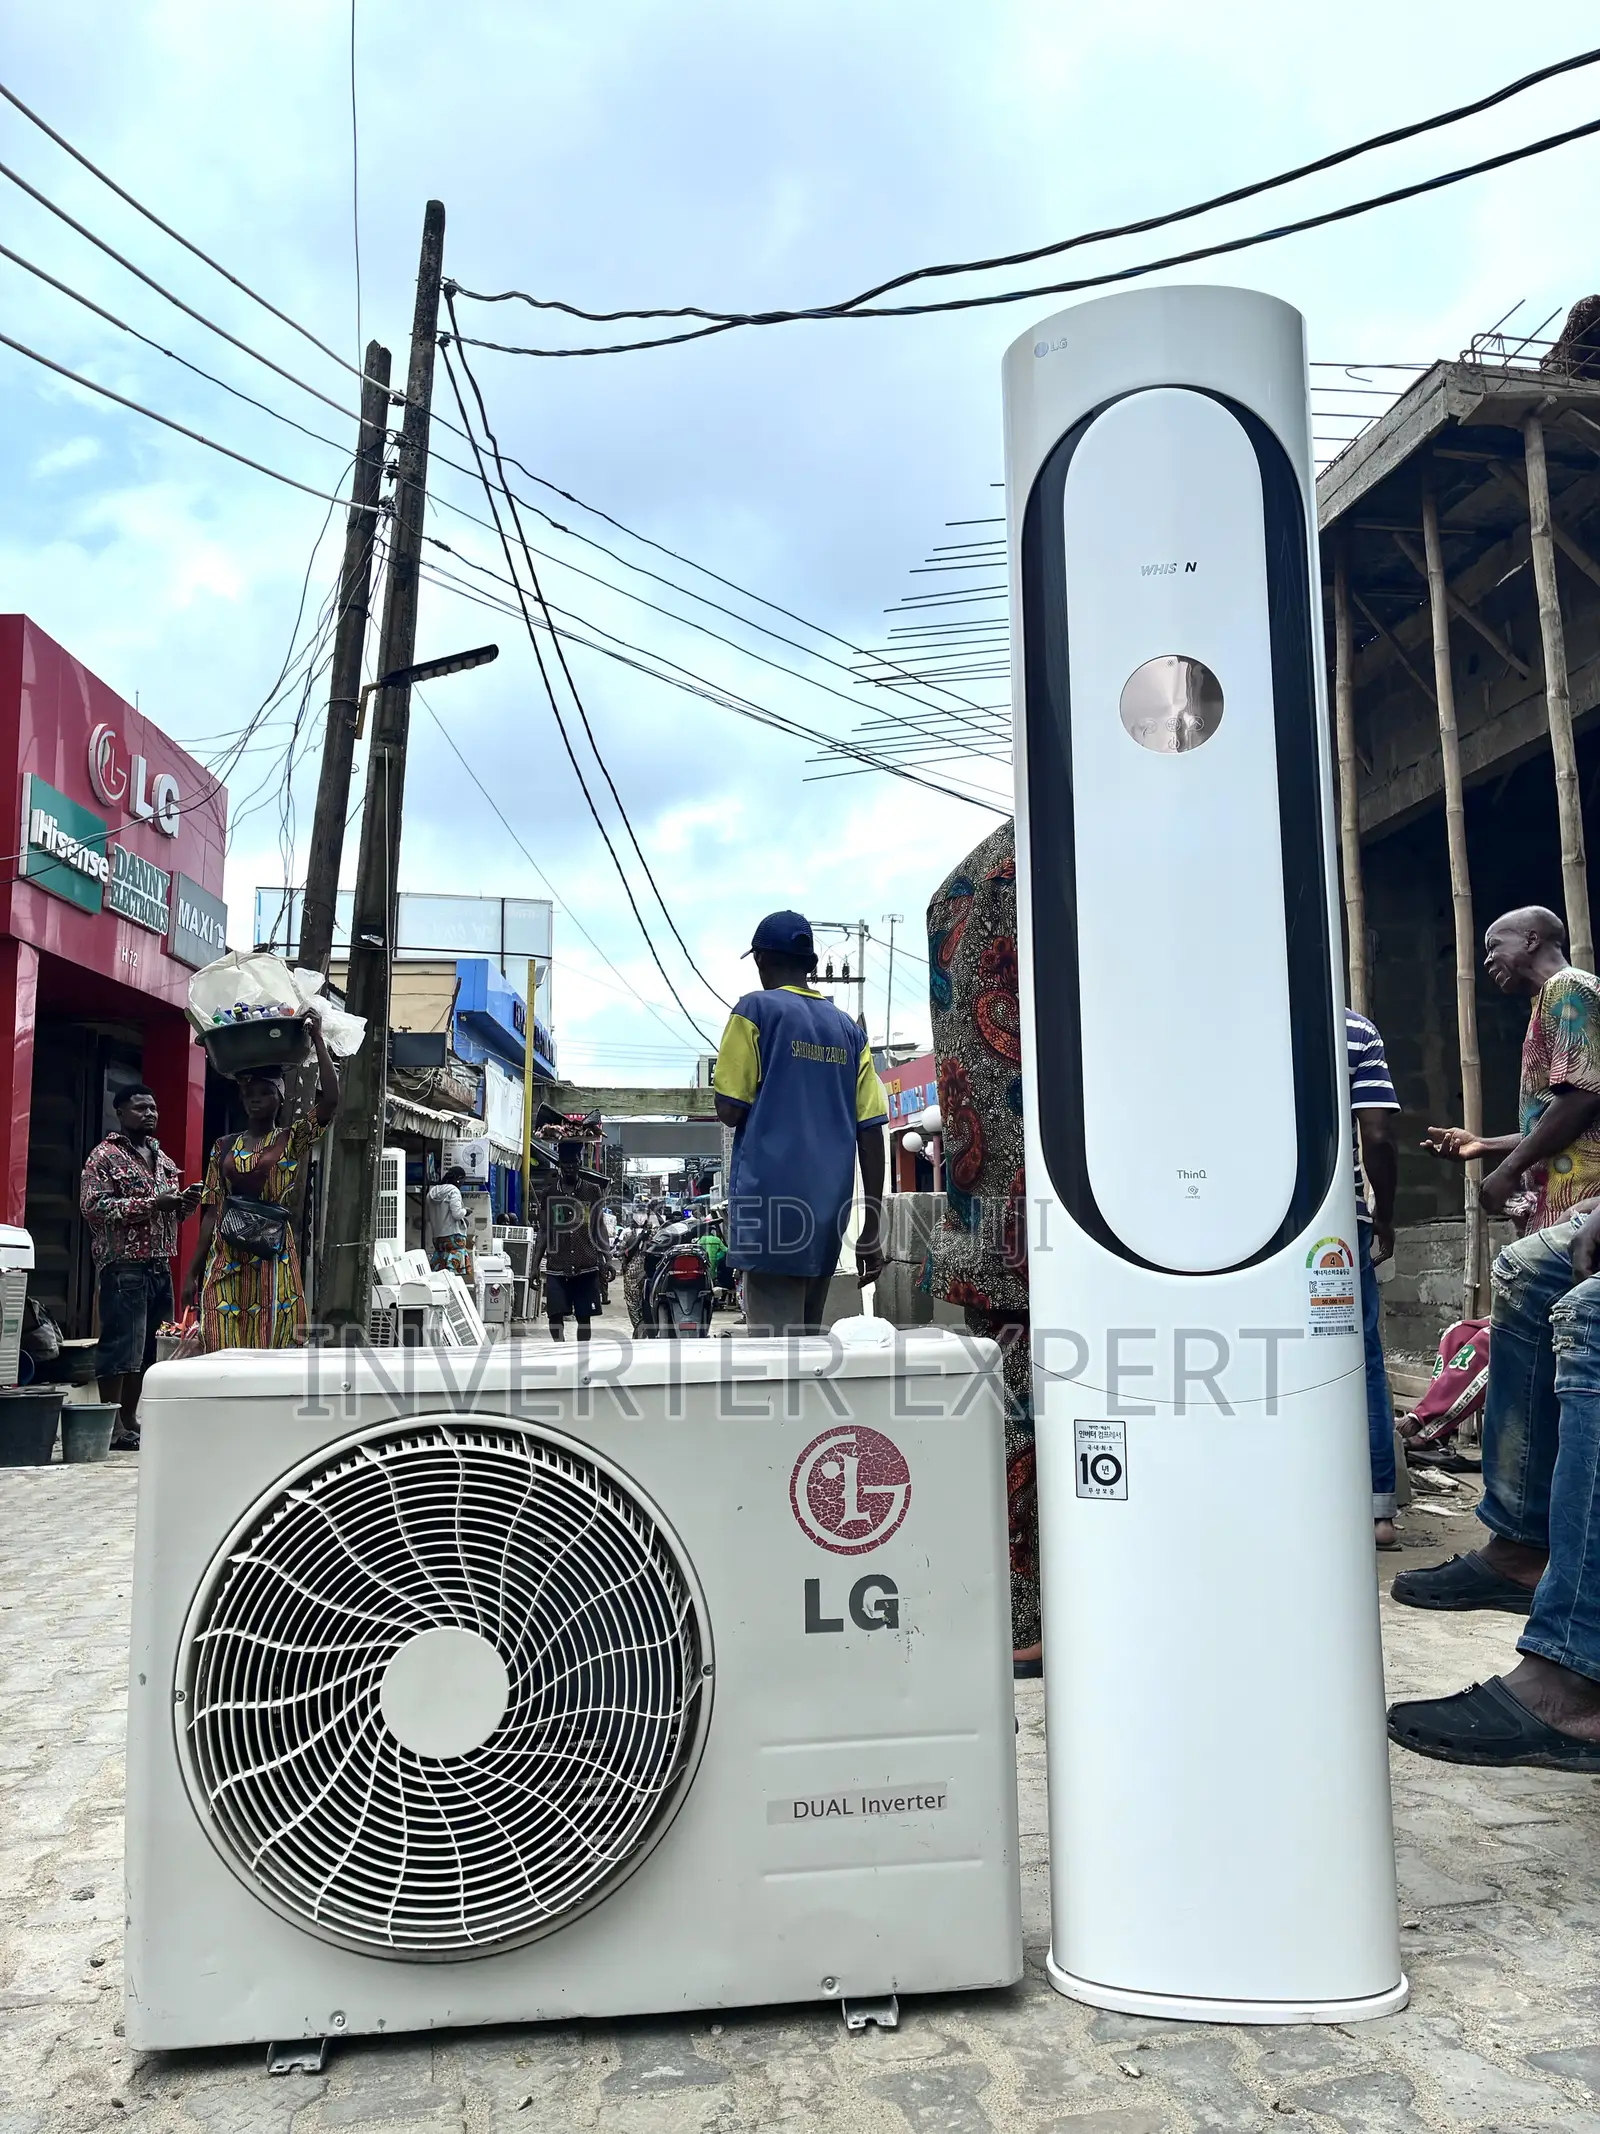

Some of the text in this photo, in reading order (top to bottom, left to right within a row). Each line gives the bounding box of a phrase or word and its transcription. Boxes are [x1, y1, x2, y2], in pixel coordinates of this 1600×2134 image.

[1050, 337, 1067, 352] LG
[1141, 561, 1197, 576] WHISN
[130, 754, 180, 839] LG
[31, 808, 109, 883] Hisense
[112, 842, 170, 908] DANNY
[110, 882, 169, 936] ELECTRONICS
[177, 897, 213, 945] MAXI
[129, 949, 138, 968] 72
[1176, 1169, 1208, 1179] ThinQ
[1330, 1256, 1336, 1266] 4
[1449, 1344, 1477, 1371] R
[1078, 1430, 1097, 1439] 인버터
[1080, 1453, 1122, 1486] 10
[1101, 1465, 1109, 1475] 년
[804, 1573, 900, 1634] LG
[793, 1794, 946, 1818] DUAL Inverter
